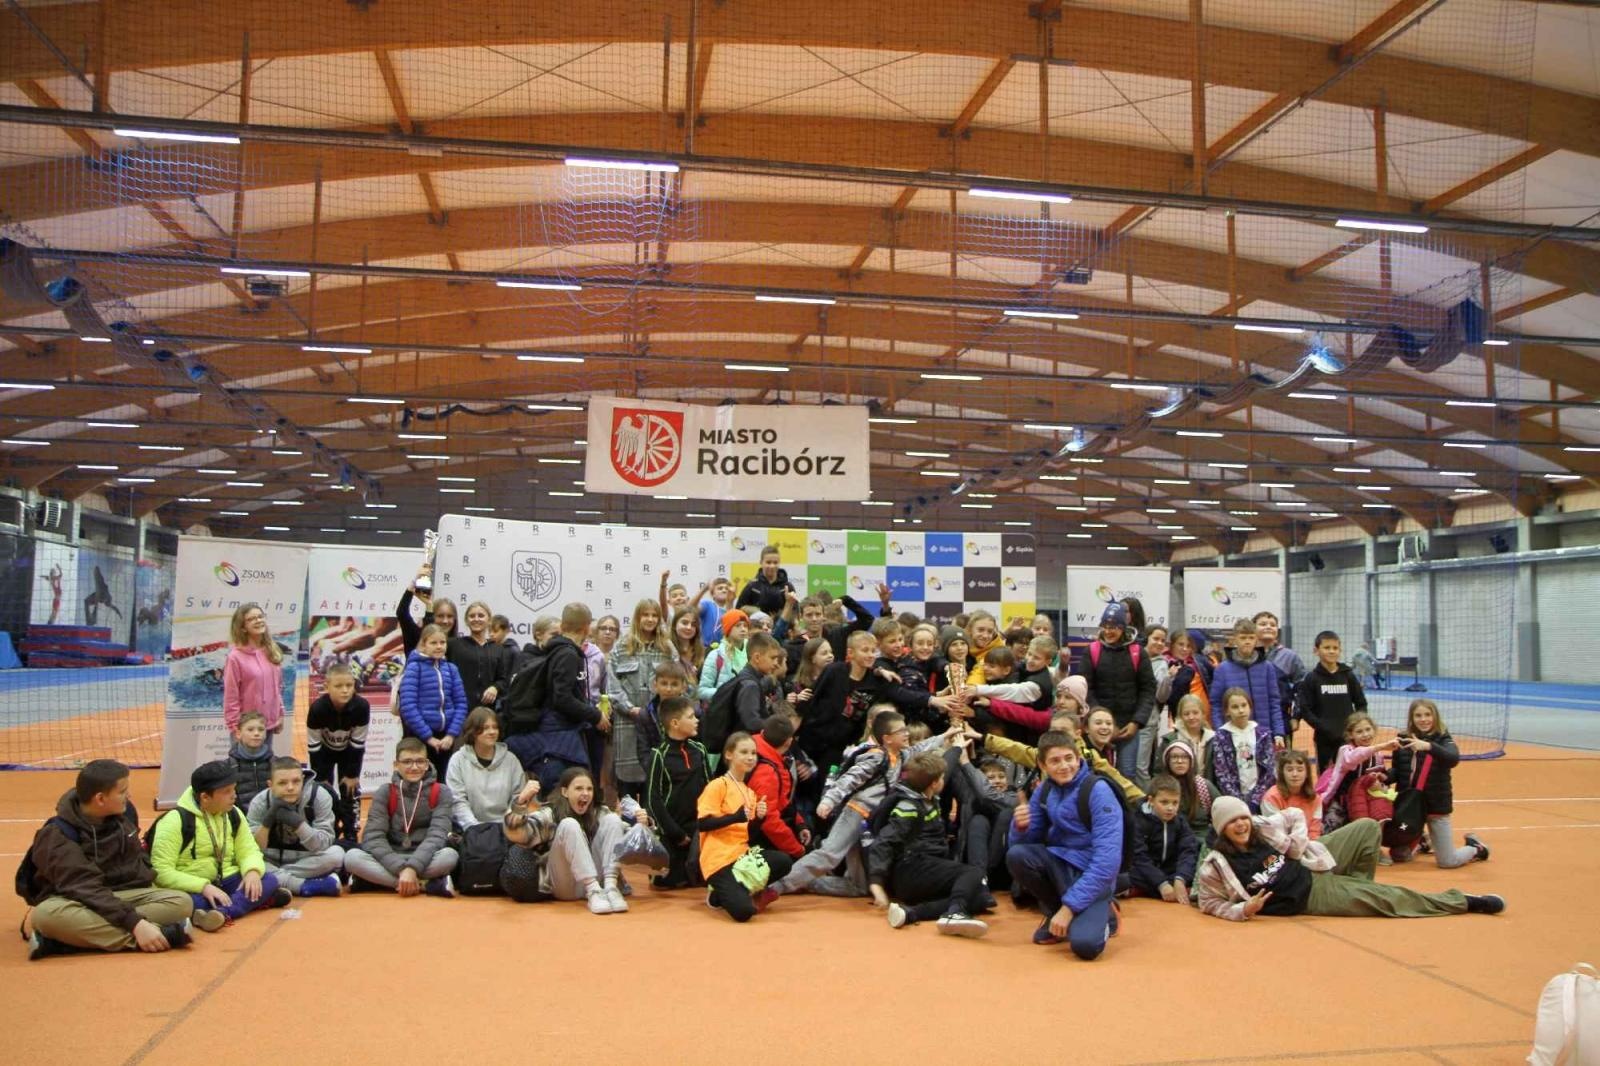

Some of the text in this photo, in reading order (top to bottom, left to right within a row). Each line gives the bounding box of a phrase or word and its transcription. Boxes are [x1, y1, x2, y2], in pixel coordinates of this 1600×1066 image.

[699, 428, 777, 444] MIASTO
[697, 447, 846, 476] Racibórz
[465, 518, 471, 526] R
[498, 522, 504, 530] R
[569, 527, 575, 535] R
[606, 528, 612, 536] R
[446, 535, 452, 543] R
[480, 538, 486, 546] R
[586, 545, 593, 553] R
[661, 547, 668, 555] R
[463, 556, 469, 564] R
[605, 563, 612, 571] R
[644, 564, 650, 572] R
[681, 564, 688, 572] R
[719, 564, 725, 572] R
[241, 569, 275, 580] ZSOMS
[367, 574, 398, 583] ZSOMS
[444, 573, 450, 582] R
[479, 576, 485, 584] R
[586, 580, 592, 588] R
[624, 581, 630, 589] R
[461, 594, 467, 602] R
[320, 600, 420, 611] Athletis
[624, 617, 629, 625] R
[1320, 684, 1348, 694] PUMA
